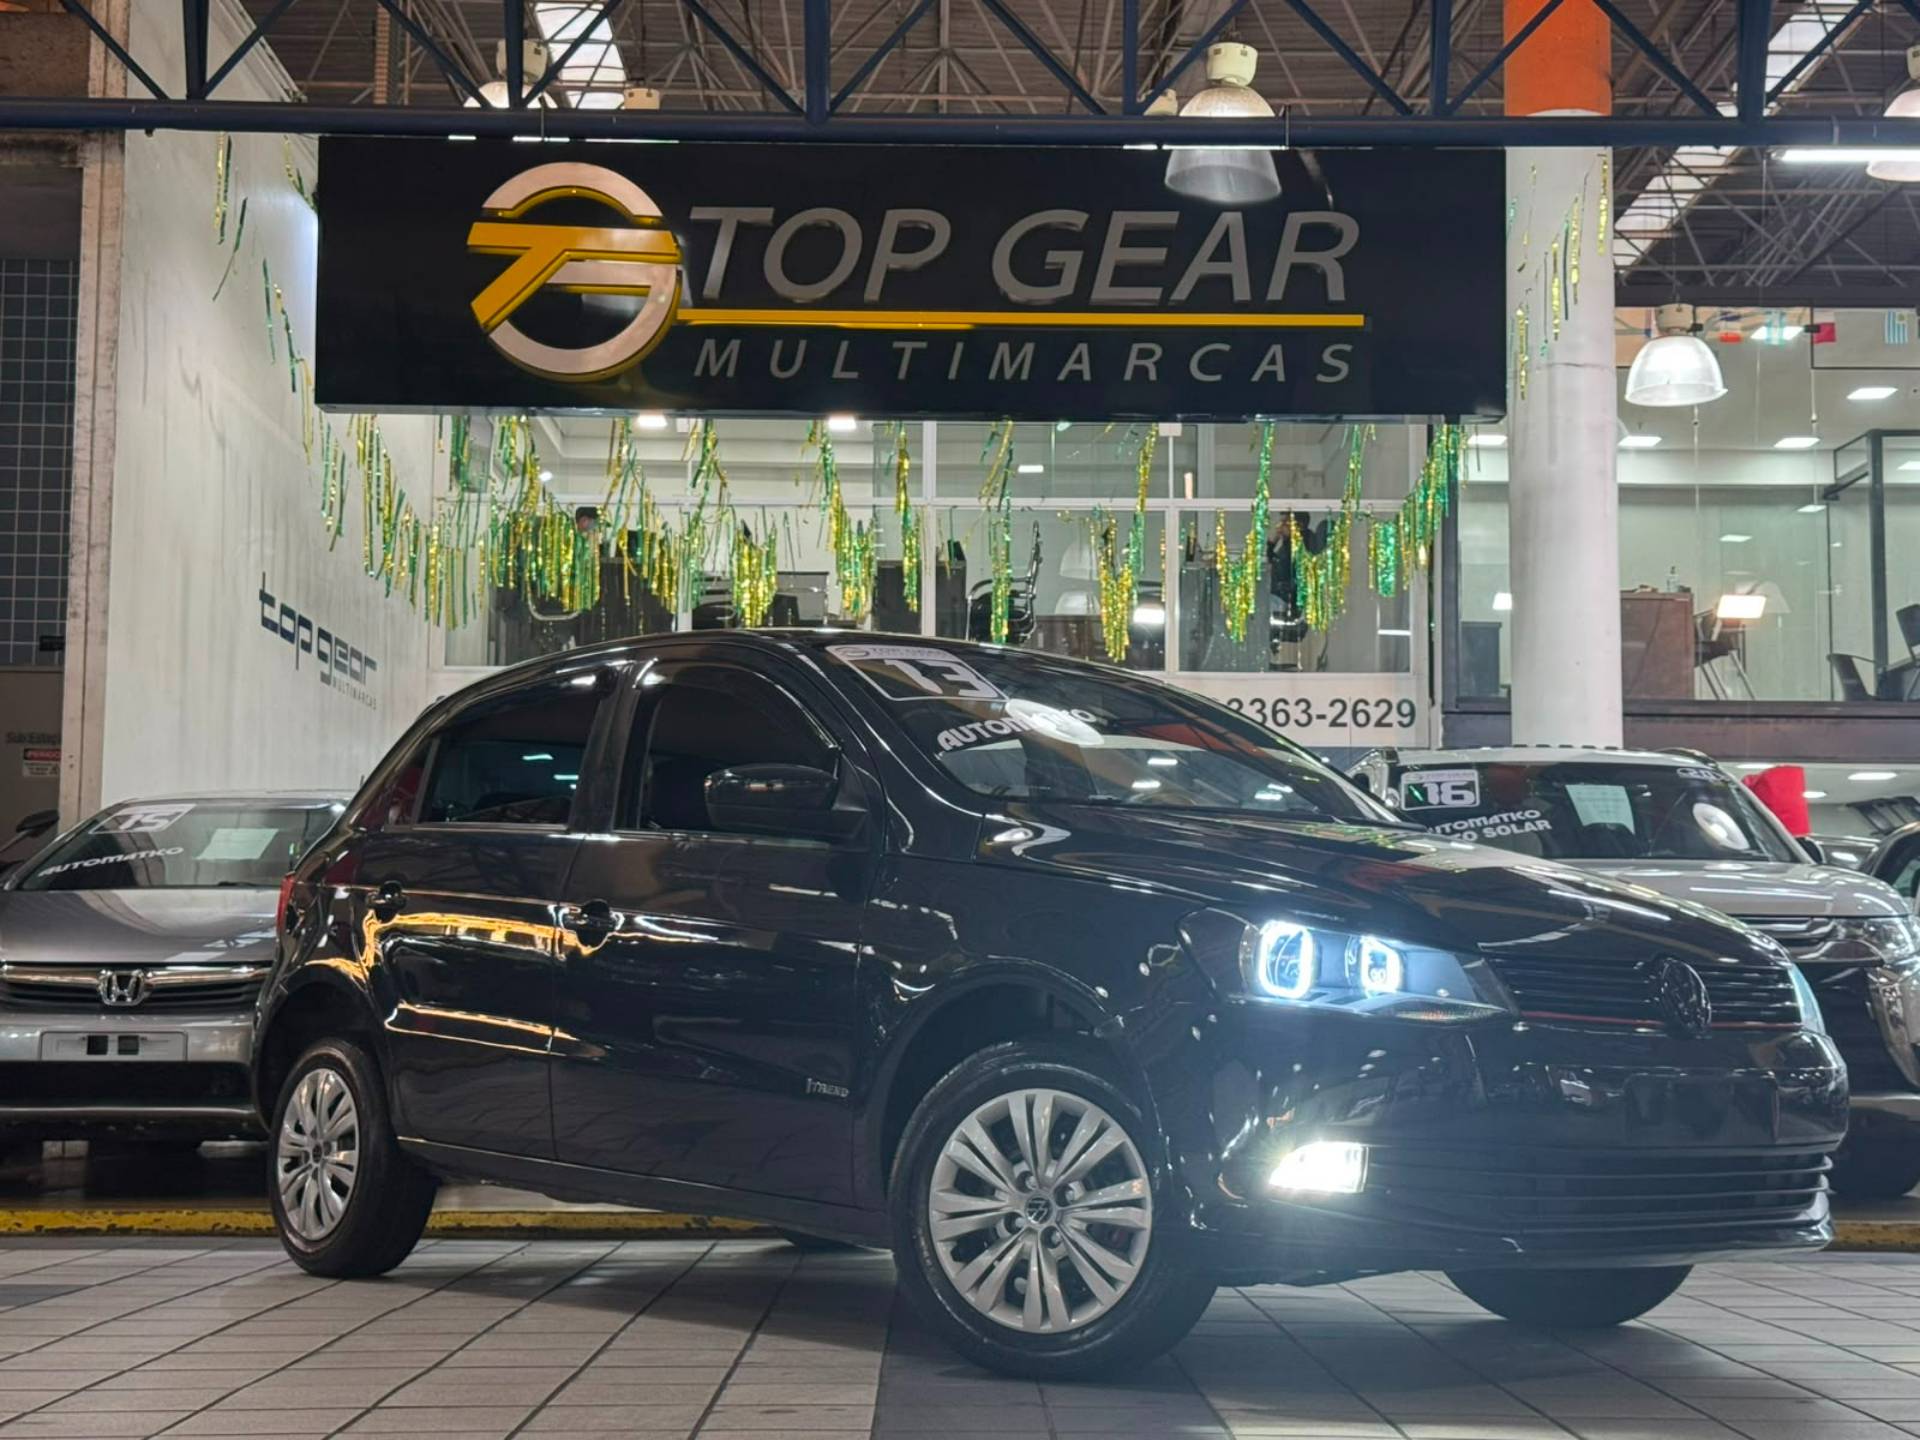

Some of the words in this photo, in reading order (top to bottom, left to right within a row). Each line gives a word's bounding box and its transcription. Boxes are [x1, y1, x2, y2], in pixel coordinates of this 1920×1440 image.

[690, 205, 952, 304] TOP
[991, 208, 1360, 305] GEAR
[694, 338, 1354, 384] MULTIMARCAS
[258, 571, 314, 671] top
[317, 626, 378, 686] gear
[883, 658, 999, 698] 13
[1422, 781, 1476, 806] 16
[1482, 819, 1553, 839] SOLAR
